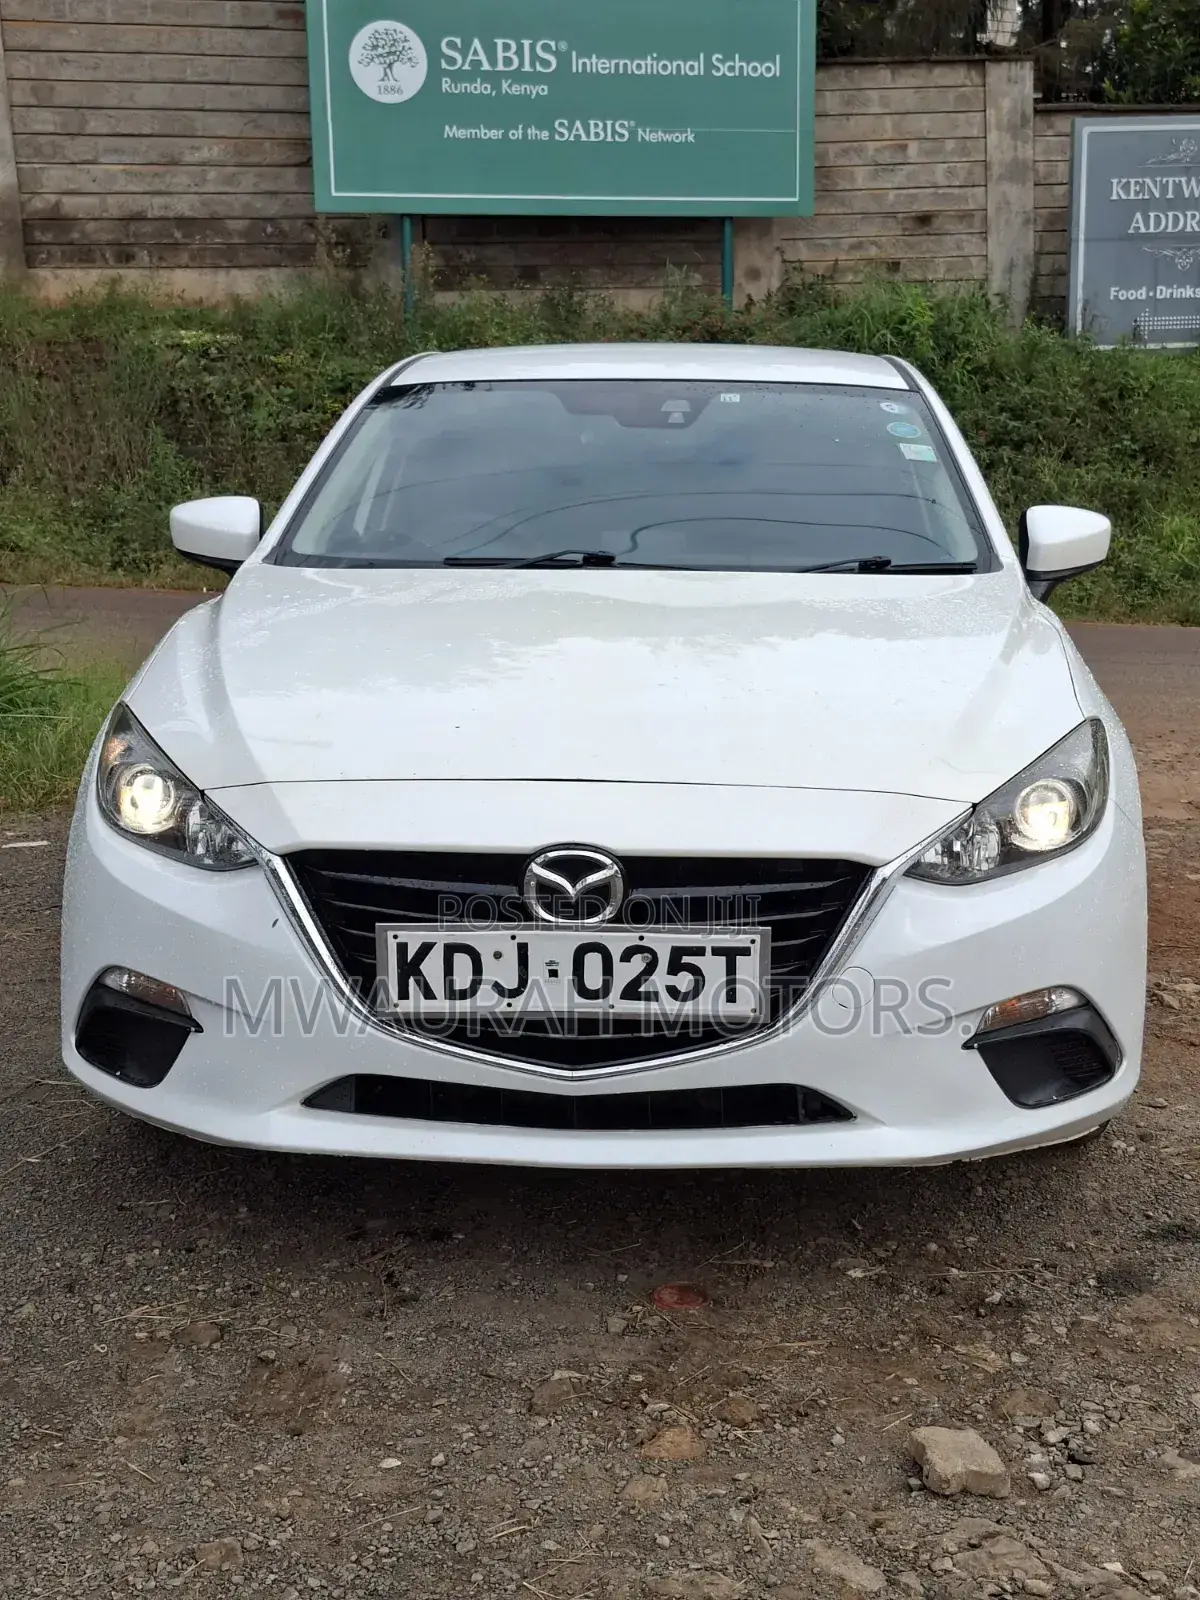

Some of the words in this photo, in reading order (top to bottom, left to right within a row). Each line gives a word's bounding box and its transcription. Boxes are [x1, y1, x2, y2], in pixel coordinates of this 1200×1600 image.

[571, 50, 704, 76] International
[711, 53, 781, 78] School
[376, 84, 403, 97] 1886
[441, 77, 497, 97] Runda,
[501, 79, 549, 99] Kenya
[443, 124, 505, 140] Member
[508, 124, 524, 141] of
[527, 127, 550, 141] the
[637, 127, 696, 143] Network
[1127, 210, 1200, 234] ADDR
[1109, 285, 1147, 300] Food
[396, 941, 529, 1001] KDJ
[572, 941, 752, 1004] 025T
